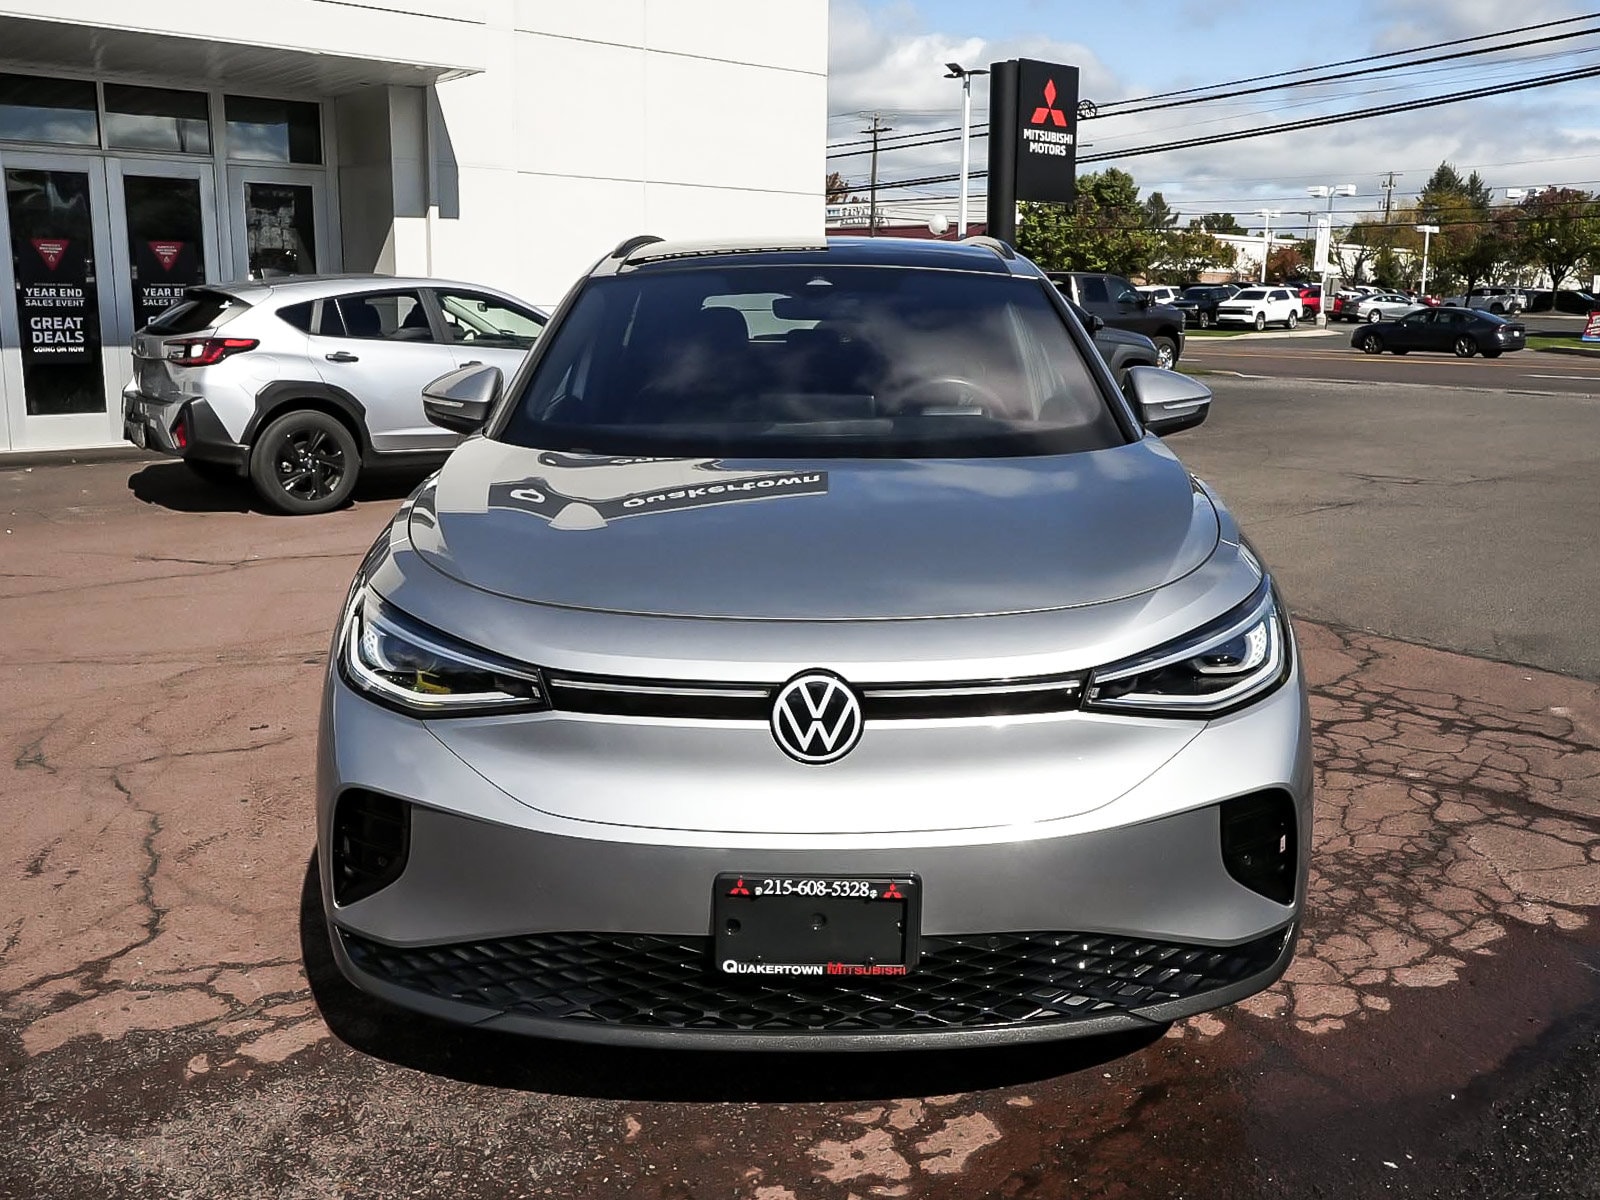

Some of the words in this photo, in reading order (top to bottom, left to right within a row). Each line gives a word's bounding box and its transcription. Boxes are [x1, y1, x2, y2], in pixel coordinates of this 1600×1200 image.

[1023, 128, 1073, 145] MITSUBISHI
[1029, 141, 1067, 157] MOTORS
[25, 287, 57, 297] YEAR
[59, 288, 83, 297] END
[142, 287, 172, 297] YEAR
[25, 299, 54, 307] SALES
[55, 299, 85, 307] EVENT
[30, 316, 84, 330] GREAT
[32, 330, 85, 344] DEALS
[763, 879, 870, 897] 215-608-5328
